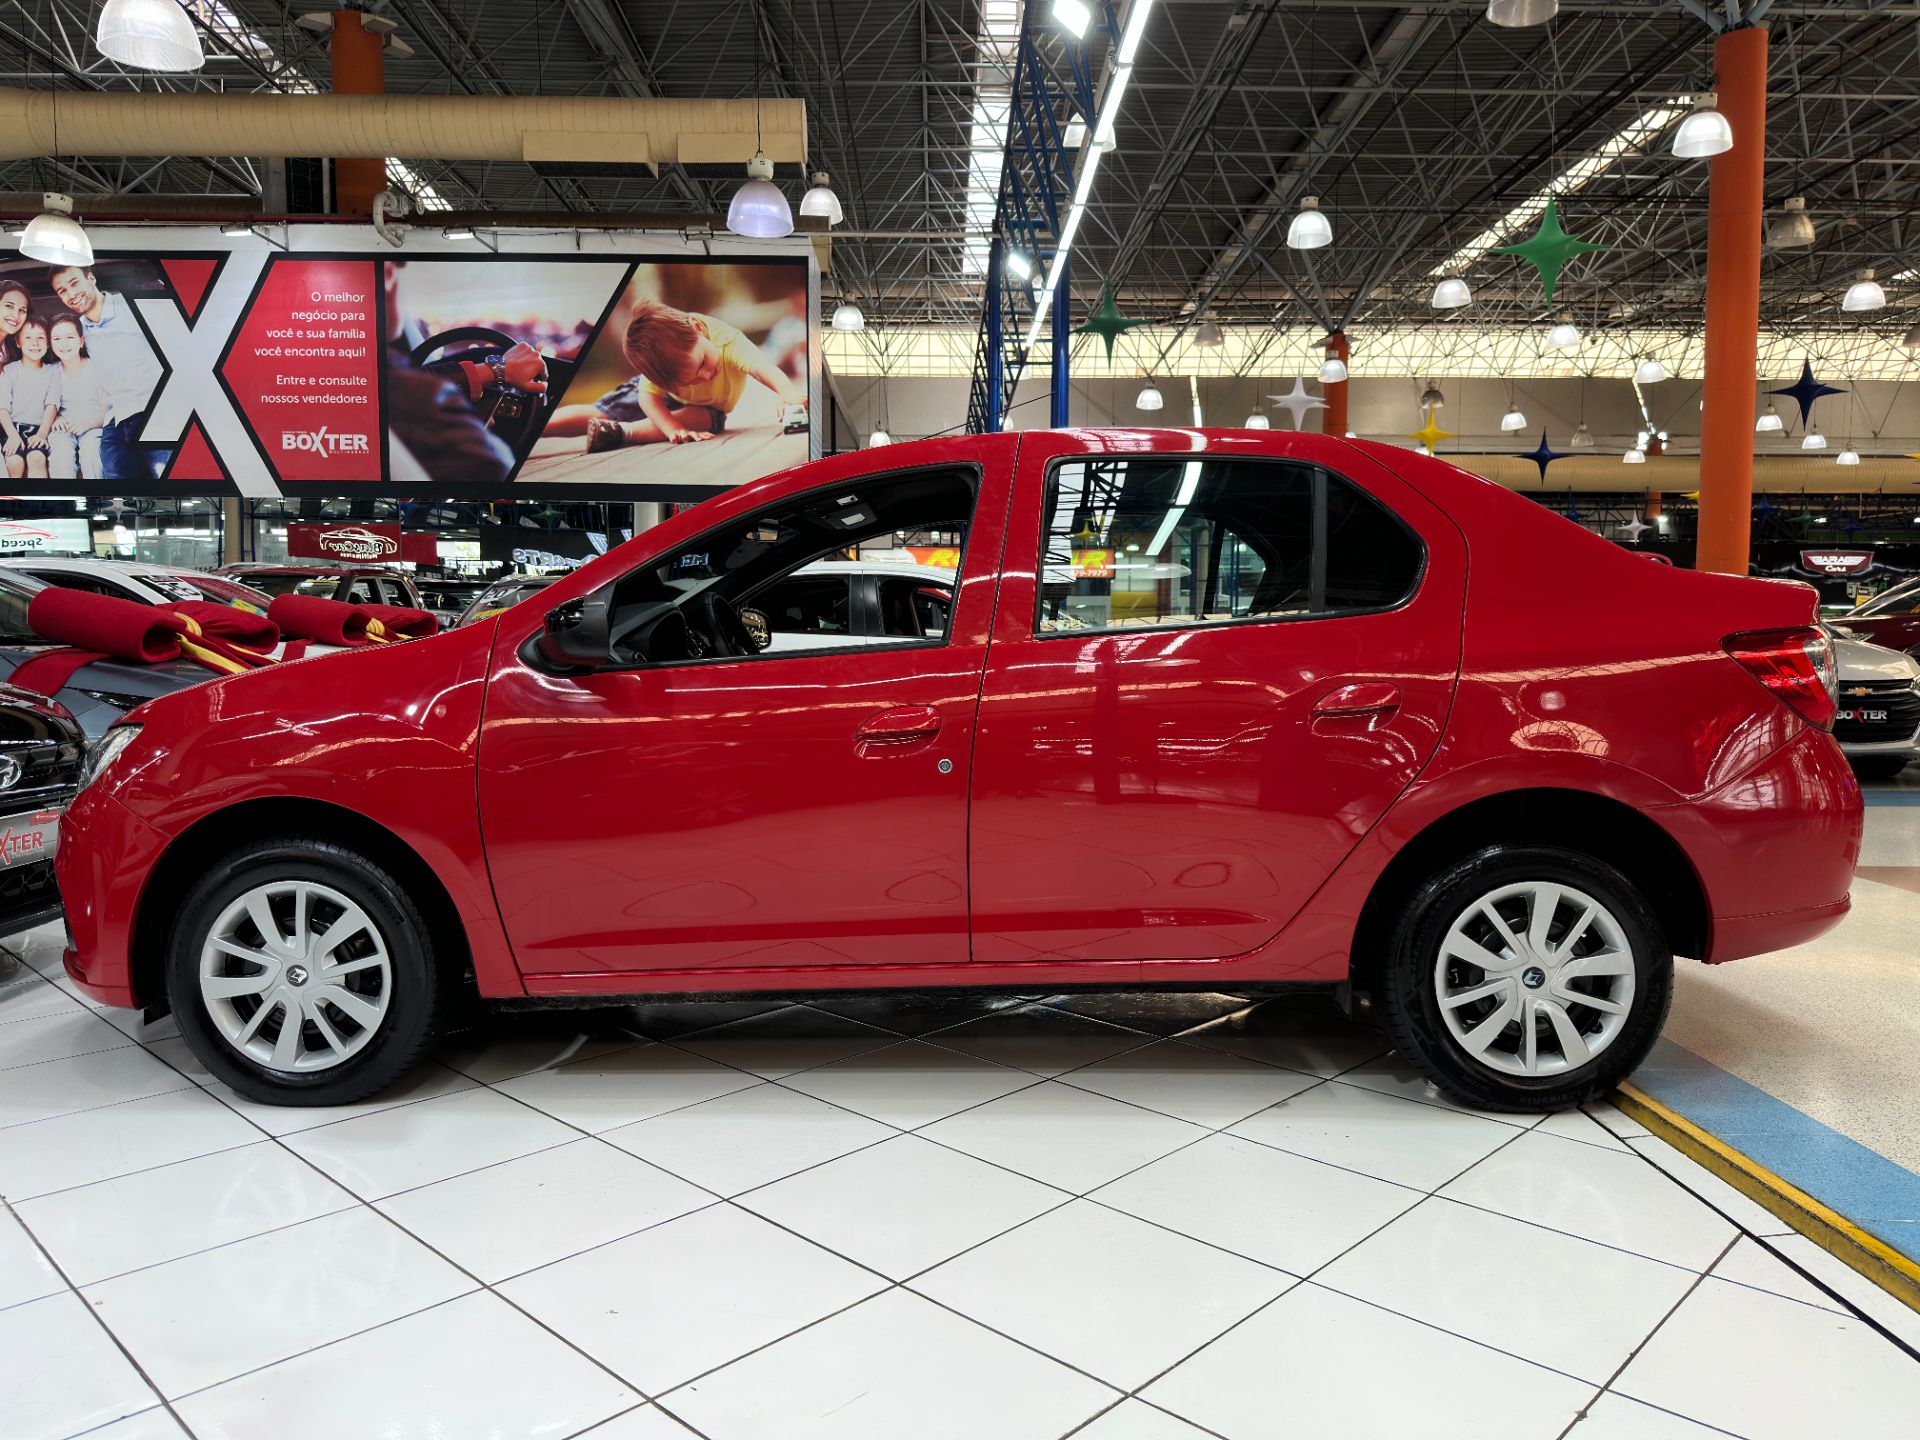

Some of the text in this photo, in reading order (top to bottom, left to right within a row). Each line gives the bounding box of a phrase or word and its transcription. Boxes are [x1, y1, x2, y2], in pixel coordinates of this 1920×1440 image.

[311, 291, 365, 302] O melhor
[291, 310, 365, 322] negócio para
[266, 328, 366, 339] você e sua família
[254, 346, 366, 359] você encontra aqui!
[276, 374, 306, 385] Entre
[318, 375, 367, 386] consulte
[261, 394, 368, 404] nossos vendedores
[282, 426, 369, 458] BOXTER
[1836, 707, 1887, 723] BOXTER
